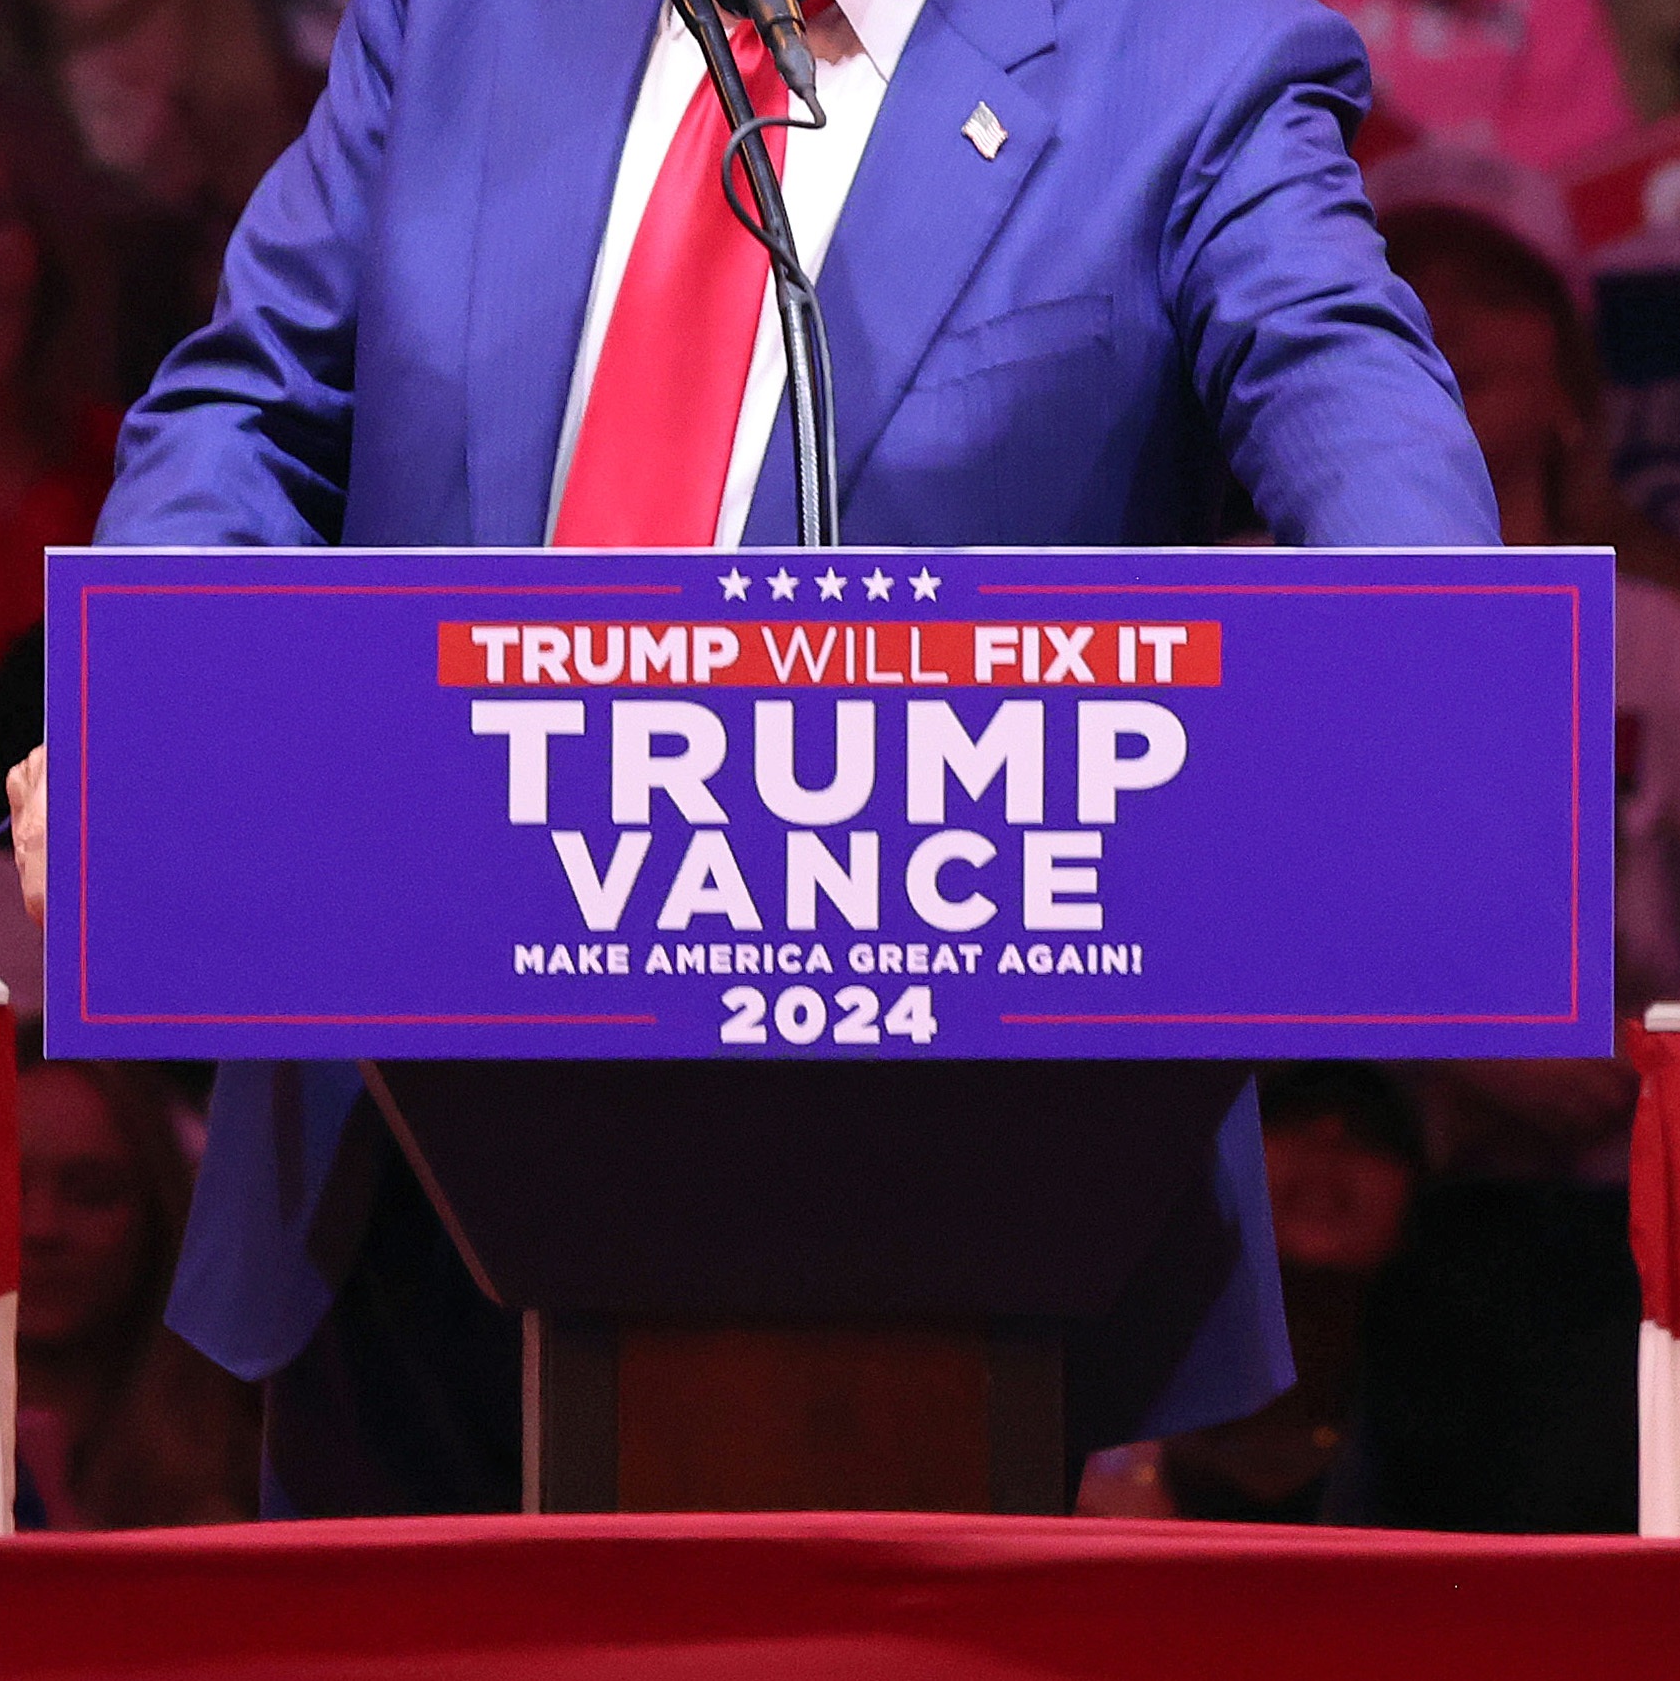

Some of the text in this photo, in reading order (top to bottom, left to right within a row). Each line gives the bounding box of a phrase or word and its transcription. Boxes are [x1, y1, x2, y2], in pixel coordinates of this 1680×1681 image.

[471, 625, 1188, 684] TRUMP WILL FIX IT
[471, 699, 1188, 826] TRUMP
[551, 829, 1104, 933] VANCE
[514, 943, 1144, 975] MAKE AMERICA GREAT AGAIN!
[720, 985, 938, 1045] 2024
